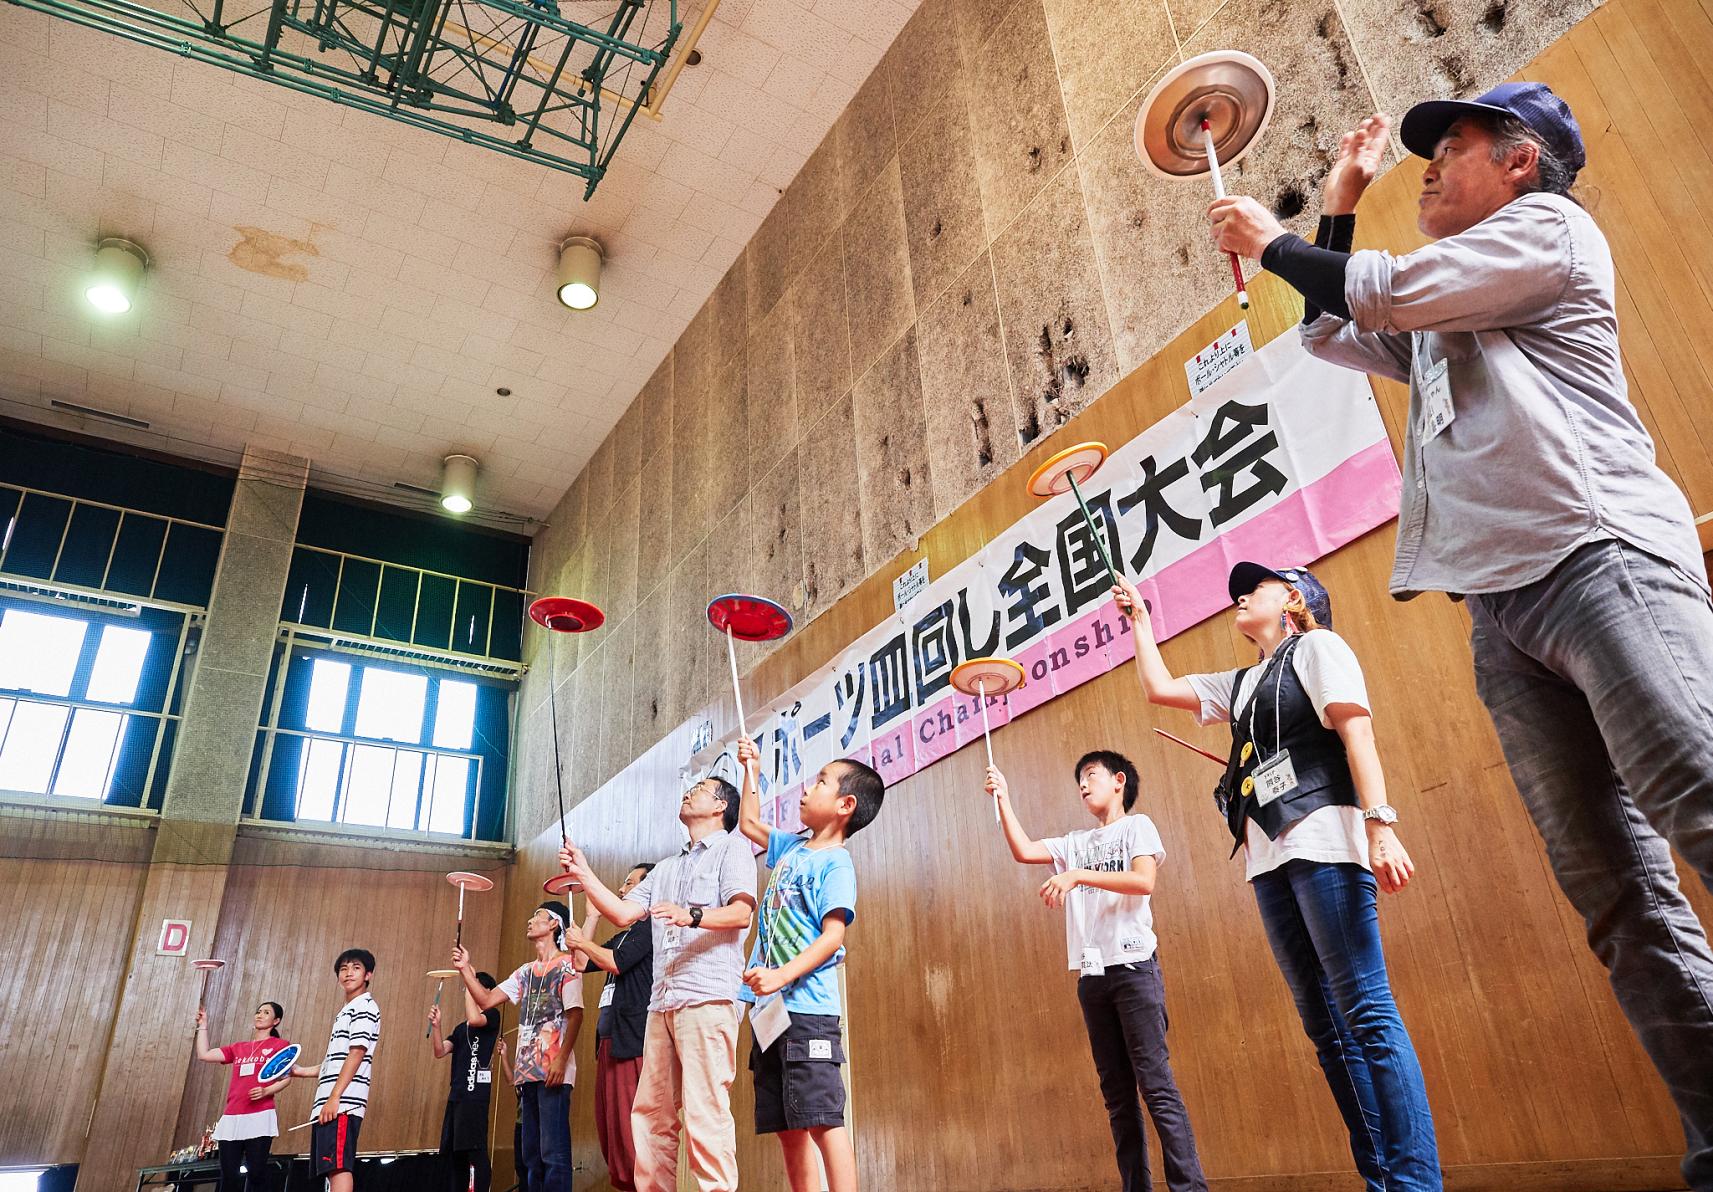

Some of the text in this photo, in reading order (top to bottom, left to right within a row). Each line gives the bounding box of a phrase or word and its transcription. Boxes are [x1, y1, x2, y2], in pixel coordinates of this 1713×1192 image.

[919, 599, 1152, 743] Chamonshi
[163, 924, 187, 950] D
[467, 1056, 478, 1092] adidas
